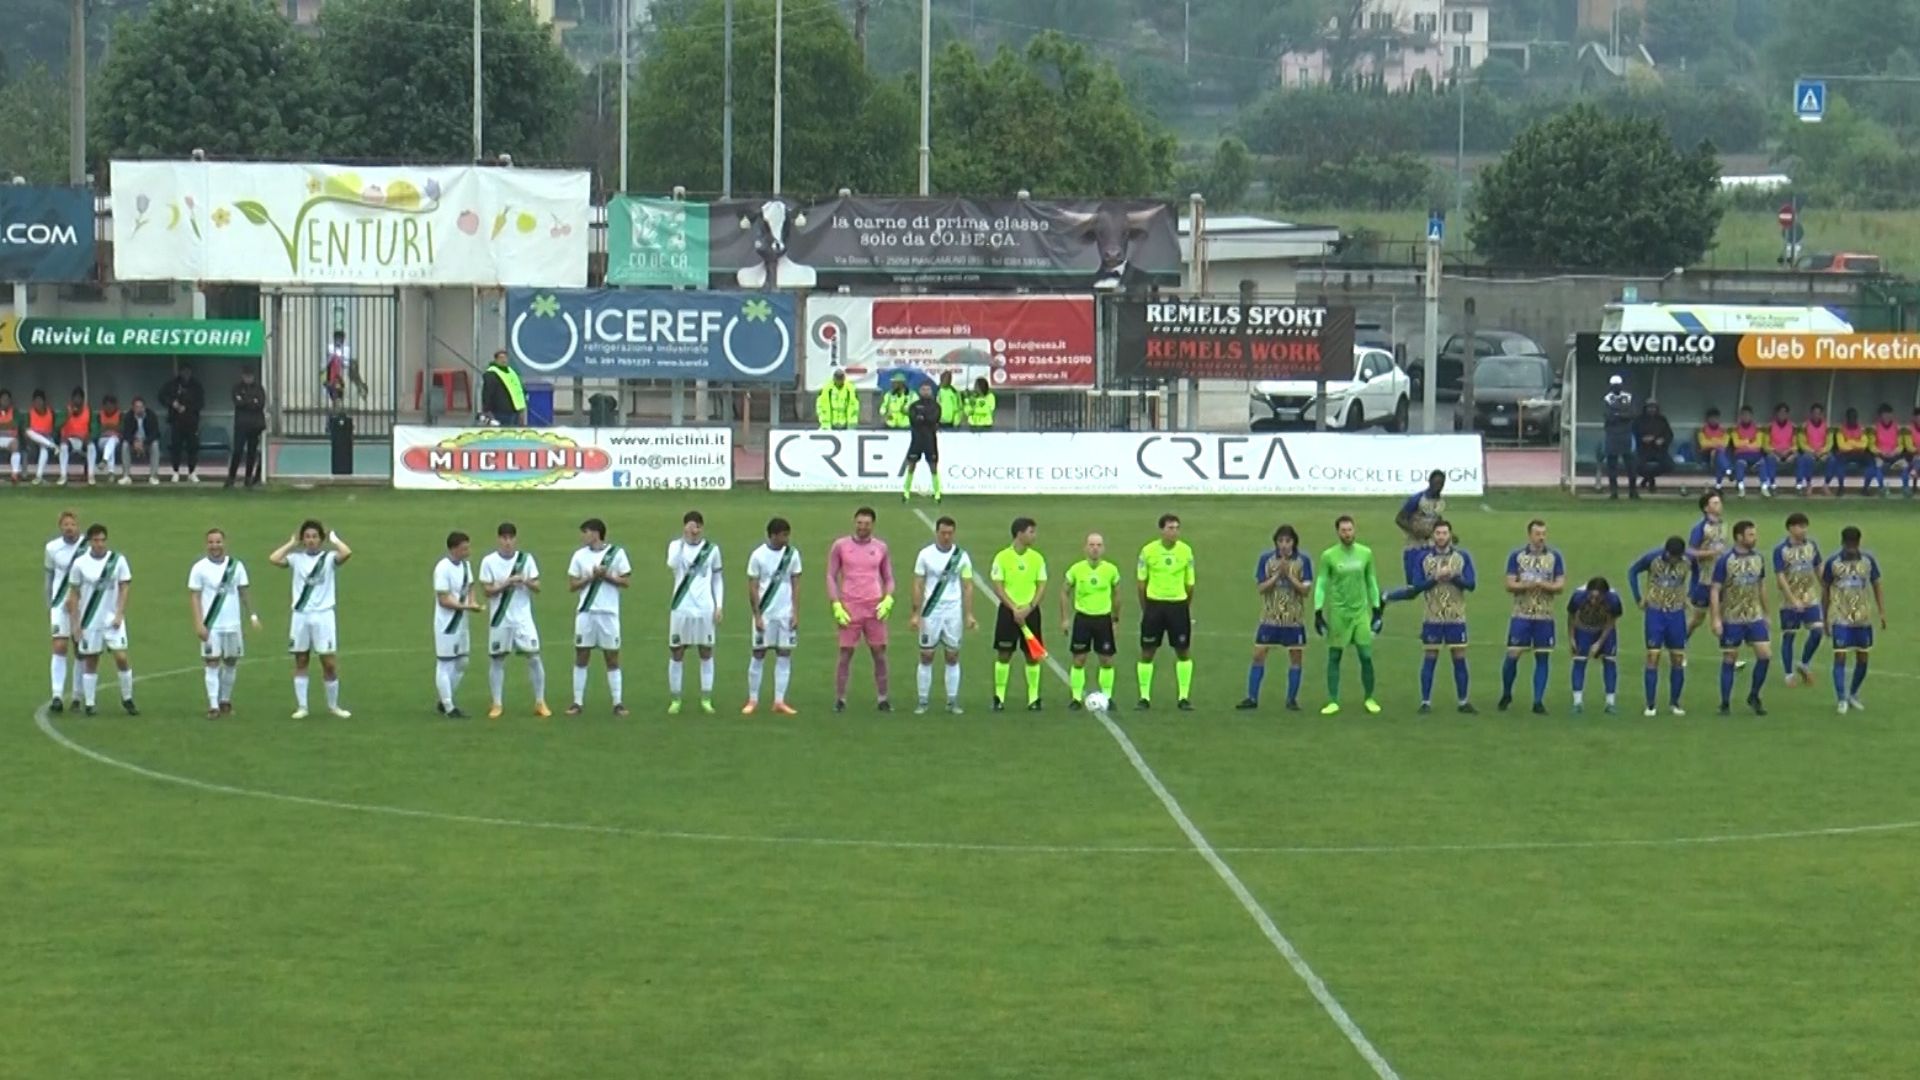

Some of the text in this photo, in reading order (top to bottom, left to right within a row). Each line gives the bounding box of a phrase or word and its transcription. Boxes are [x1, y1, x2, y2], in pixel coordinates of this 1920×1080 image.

[263, 197, 435, 275] VENTURI
[832, 216, 1049, 237] la carne di prima classe
[860, 233, 897, 246] solo
[902, 233, 924, 246] da
[584, 309, 722, 342] ICEREF
[1146, 304, 1327, 327] REMELS SPORT
[31, 326, 251, 347] Rivivi la PREISTORIA!
[1152, 326, 1320, 337] FORNITURE SPORTIVE
[1146, 340, 1322, 362] REMELS WORK
[1598, 334, 1715, 352] zeven.co
[1756, 337, 1920, 360] Web Marketin
[1598, 354, 1623, 364] Your
[609, 433, 725, 445] www.miclini.it
[430, 449, 582, 470] MICLINI
[619, 453, 725, 469] info@miclini.it
[1137, 436, 1300, 480] CREA
[948, 465, 1119, 480] CONCRETE DESIGN
[1309, 466, 1403, 482] CONCRETE
